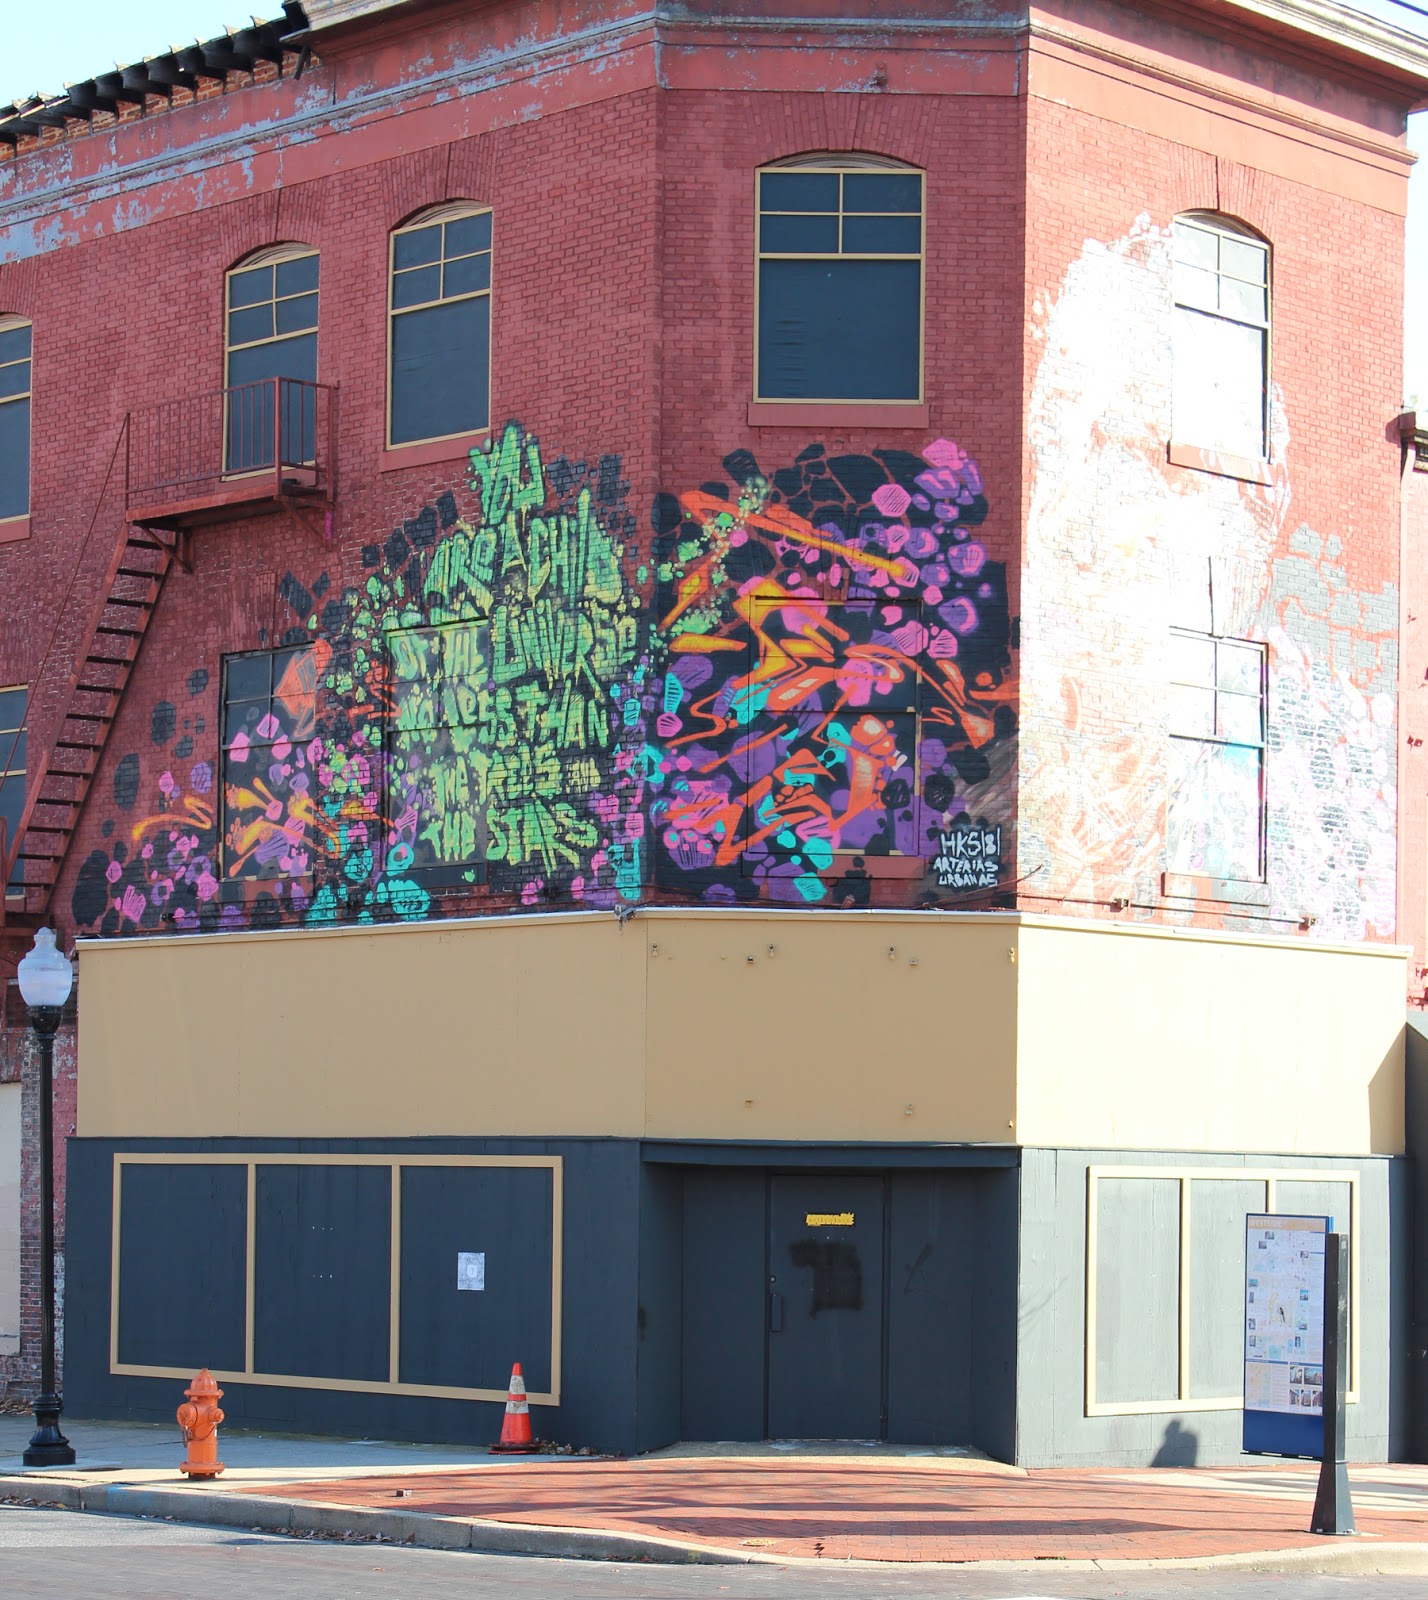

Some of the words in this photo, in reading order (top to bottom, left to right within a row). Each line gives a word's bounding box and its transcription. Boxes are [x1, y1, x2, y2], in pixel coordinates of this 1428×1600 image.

[528, 488, 623, 608] CHILD
[396, 695, 438, 751] NO
[516, 679, 609, 750] THAN
[428, 755, 470, 817] THE
[420, 811, 477, 862] THE
[486, 800, 599, 878] STARS
[933, 857, 999, 873] ARTERIAS
[1250, 1219, 1282, 1228] WESTSIDE
